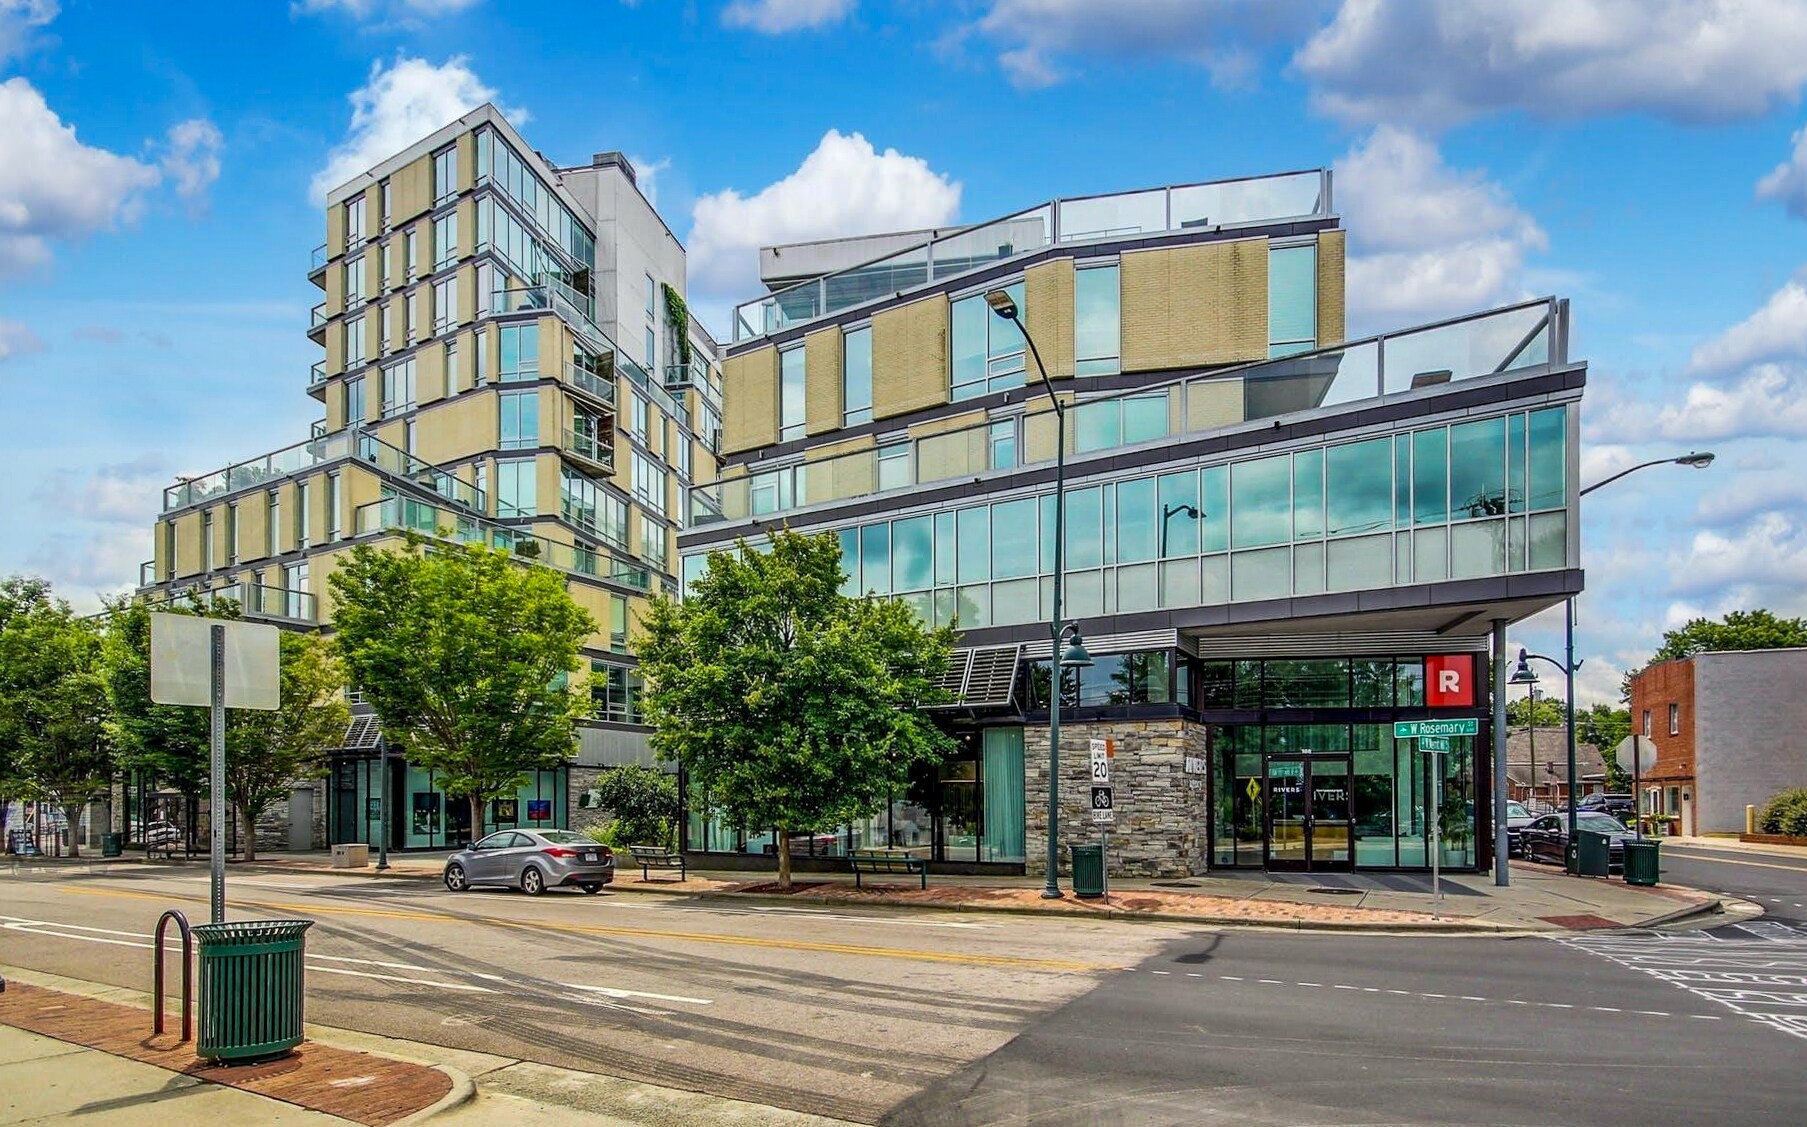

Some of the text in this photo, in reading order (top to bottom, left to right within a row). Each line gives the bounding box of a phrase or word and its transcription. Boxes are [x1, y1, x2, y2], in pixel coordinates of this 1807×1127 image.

[1439, 670, 1459, 692] R
[1410, 724, 1418, 734] W
[1420, 723, 1465, 734] Rosemary
[1093, 762, 1107, 778] 20
